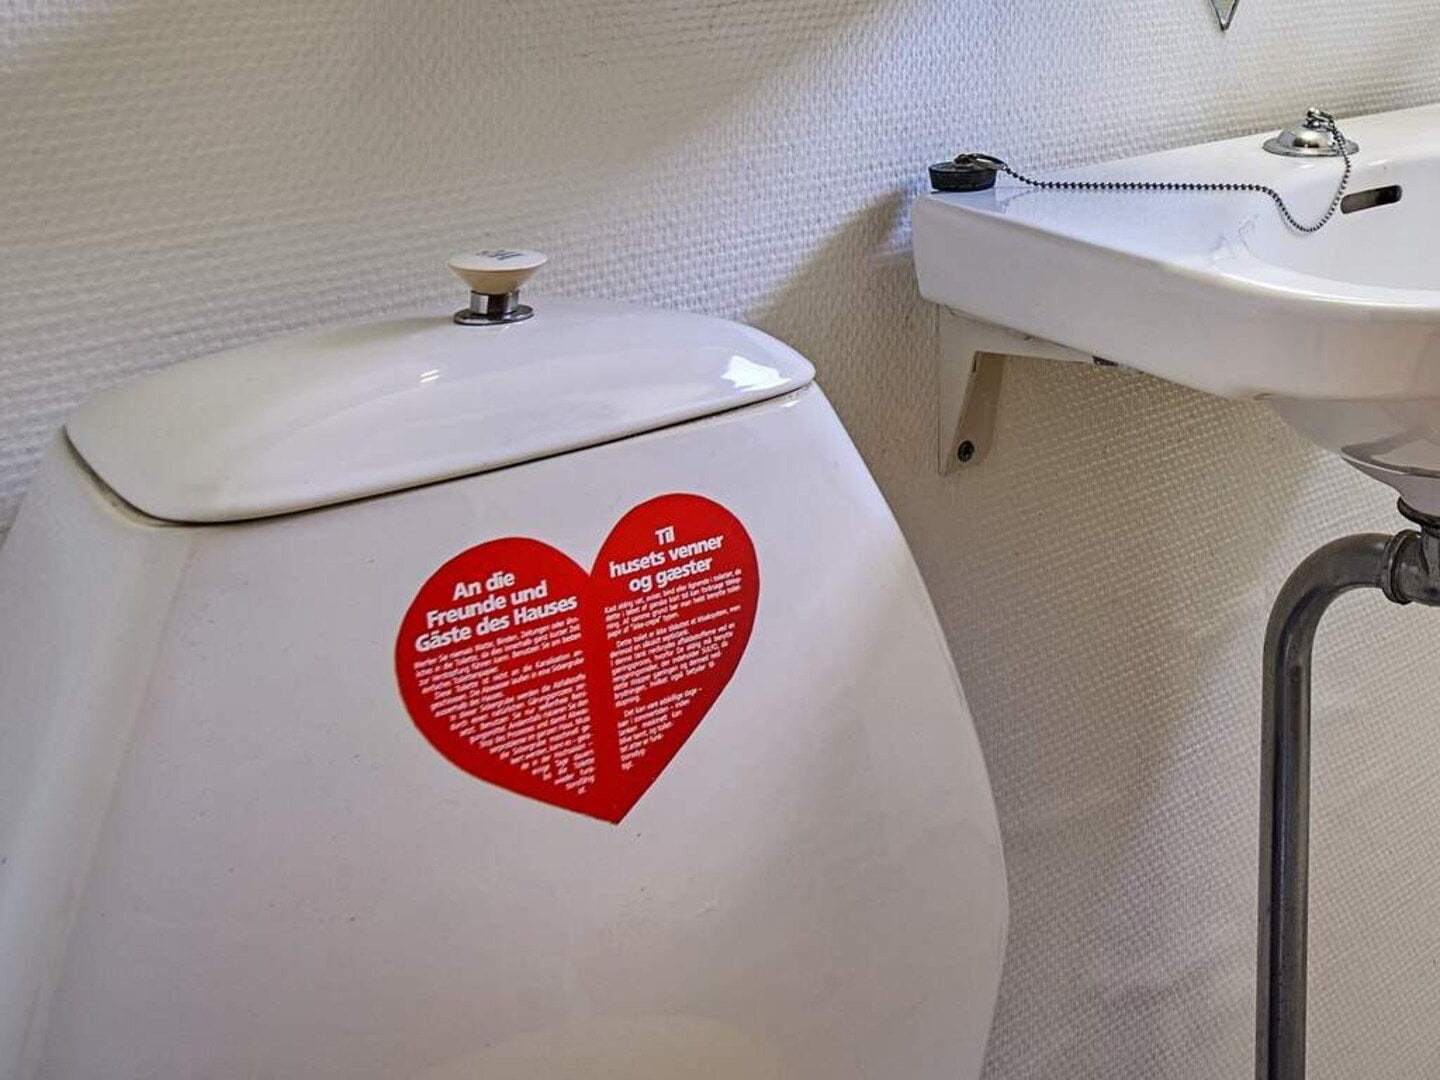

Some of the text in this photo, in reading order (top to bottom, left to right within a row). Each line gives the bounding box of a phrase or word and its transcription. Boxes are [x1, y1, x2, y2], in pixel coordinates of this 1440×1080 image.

[655, 526, 675, 545] Til
[609, 535, 723, 578] husets venner
[629, 557, 712, 592] og gæster
[427, 580, 547, 629] Freunde und
[453, 571, 515, 600] An die
[415, 596, 577, 652] Gäste des Hauses
